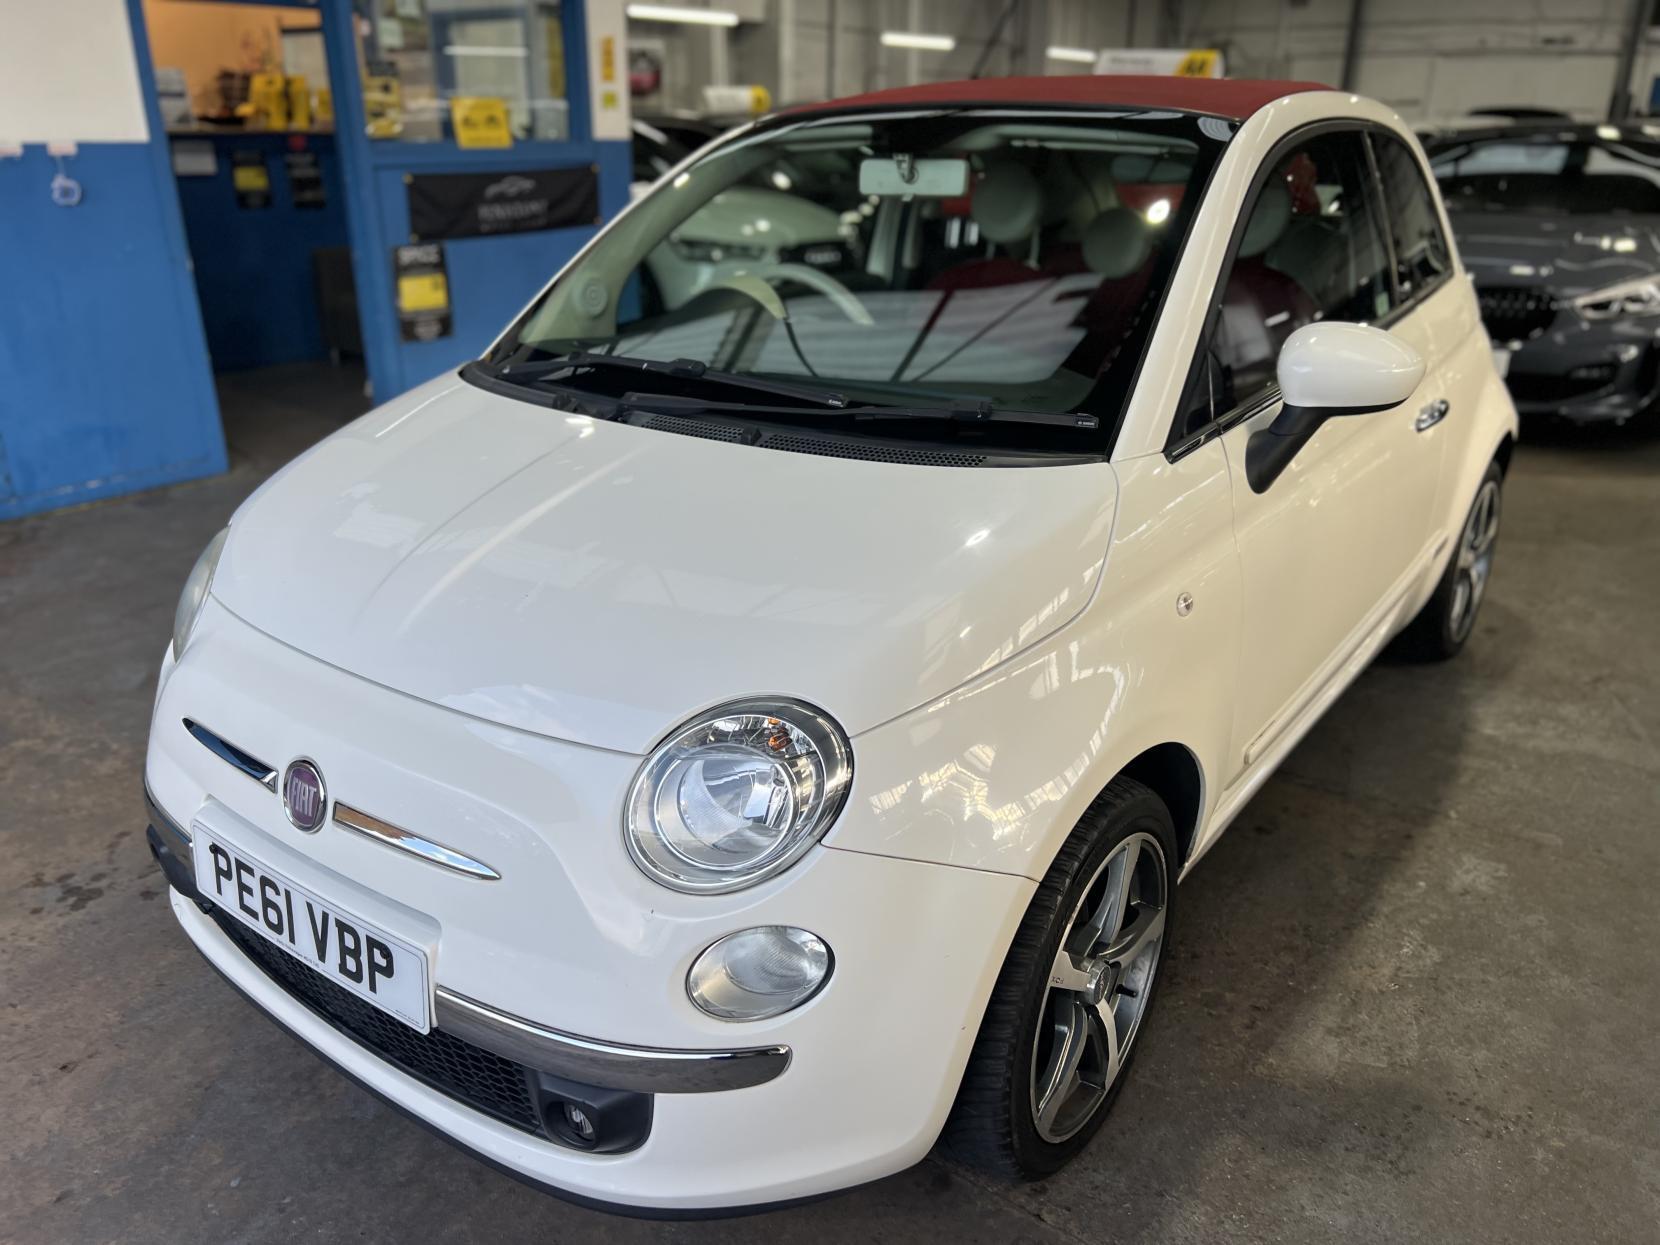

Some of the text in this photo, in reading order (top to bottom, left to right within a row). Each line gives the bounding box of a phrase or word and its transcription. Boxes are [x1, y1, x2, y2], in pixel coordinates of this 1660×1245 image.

[291, 777, 318, 817] FIAT
[210, 841, 395, 995] PE61 VBP
